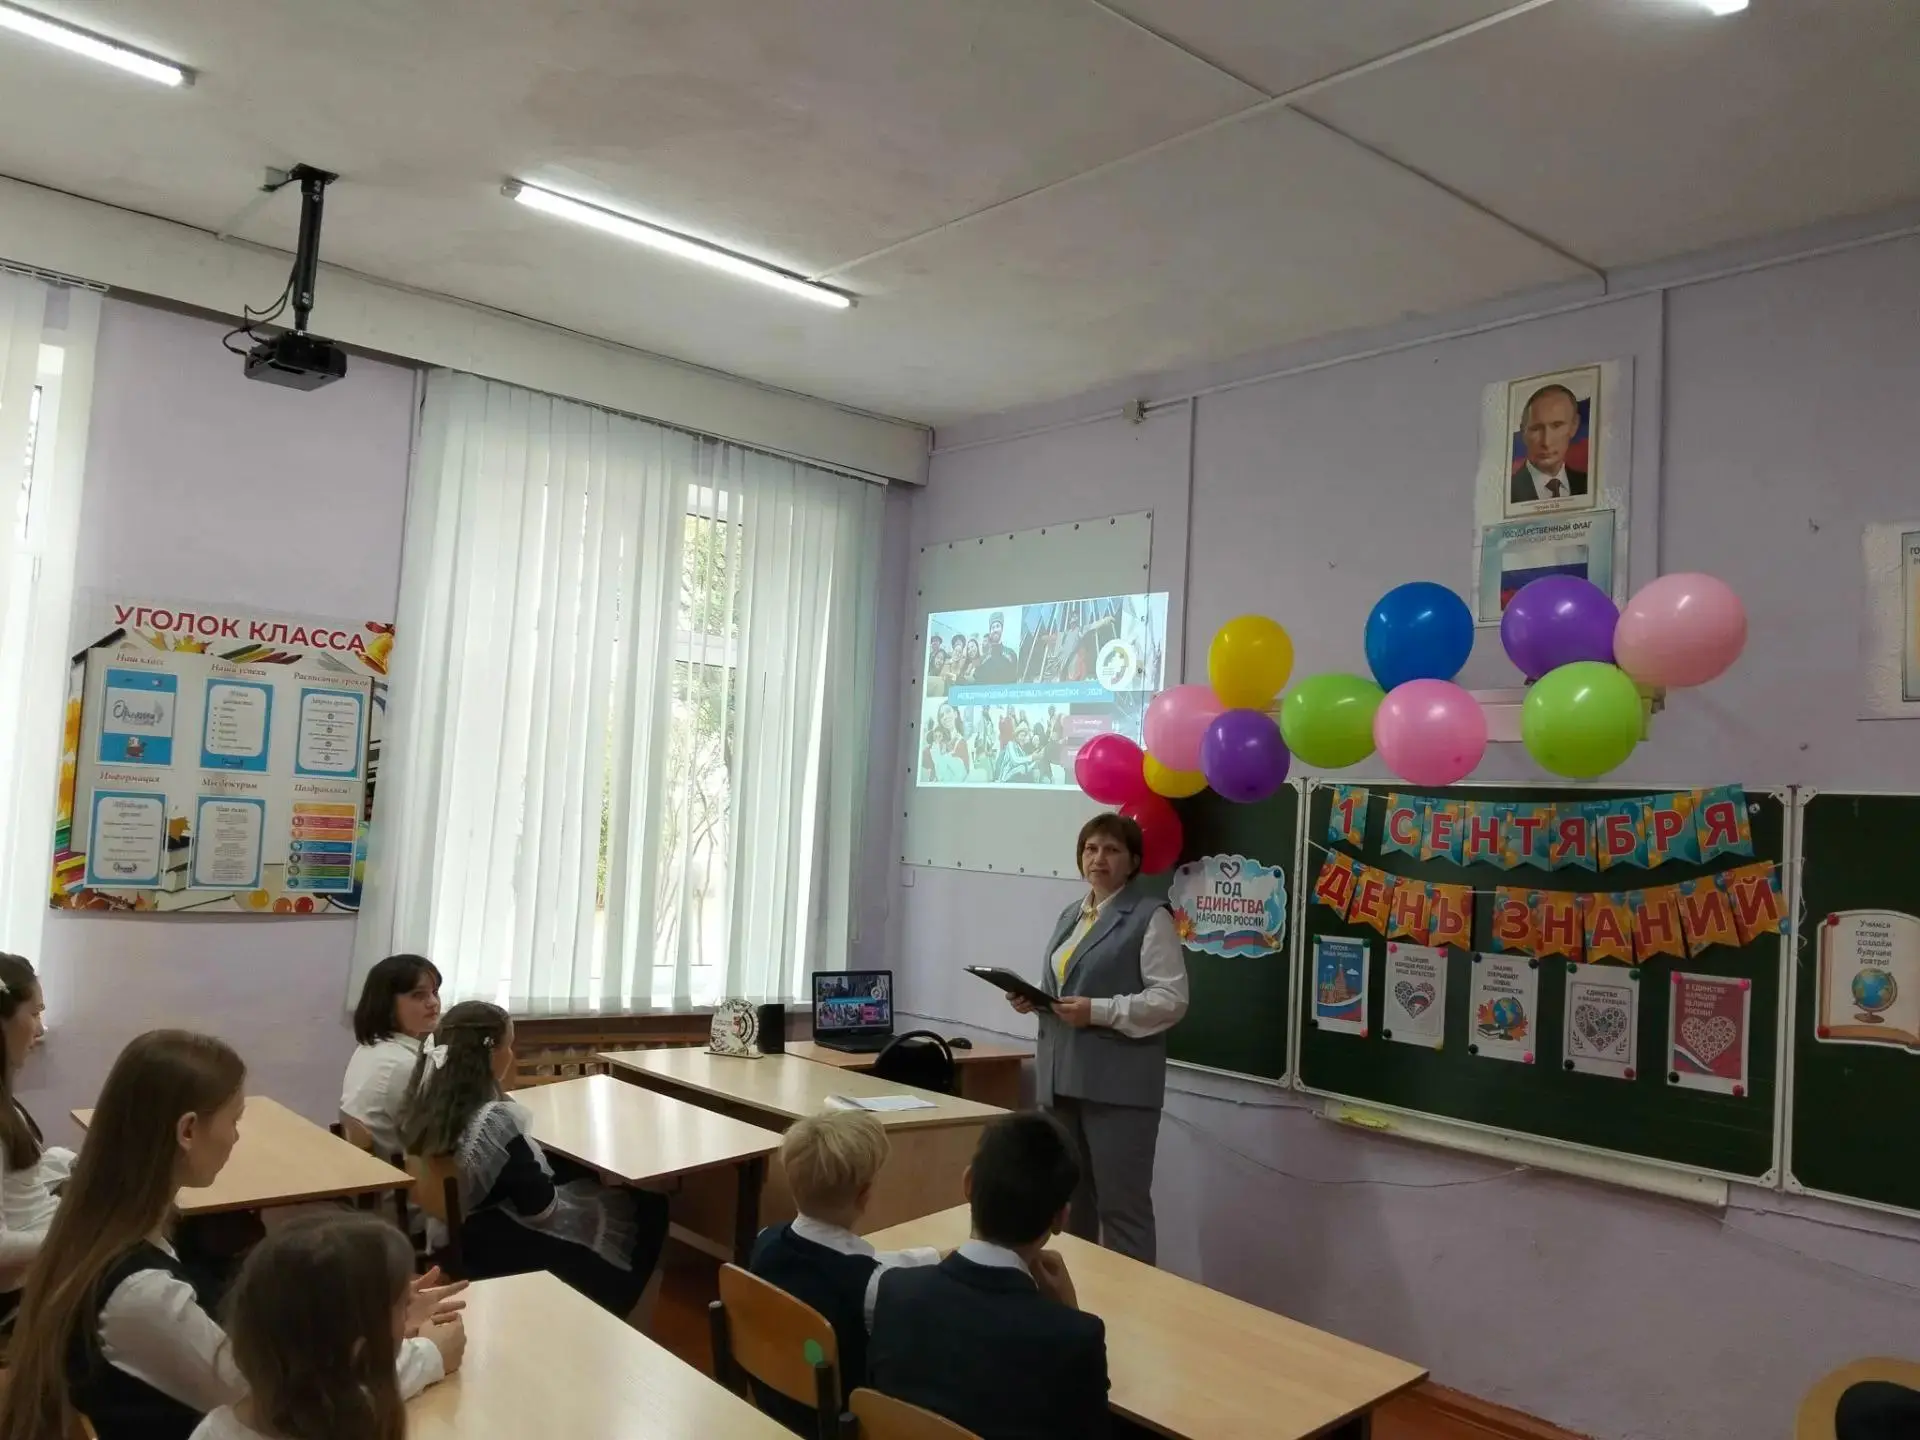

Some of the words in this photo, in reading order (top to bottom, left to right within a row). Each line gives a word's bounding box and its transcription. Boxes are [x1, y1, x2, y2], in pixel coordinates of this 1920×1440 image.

[1572, 521, 1592, 530] ФЛАГ
[114, 604, 241, 639] УГОЛОК
[249, 621, 367, 653] КЛАССА
[1337, 797, 1355, 834] 1
[1388, 801, 1741, 858] СЕНТЯБРЯ
[1215, 881, 1242, 898] ГОД
[1196, 896, 1264, 914] ЕДИНСТВА
[1317, 863, 1465, 936] ДЕНЬ
[1499, 876, 1779, 949] ЗНАНИЙ
[1196, 912, 1232, 925] НАРОДОВ
[1234, 915, 1264, 927] РОССИИ
